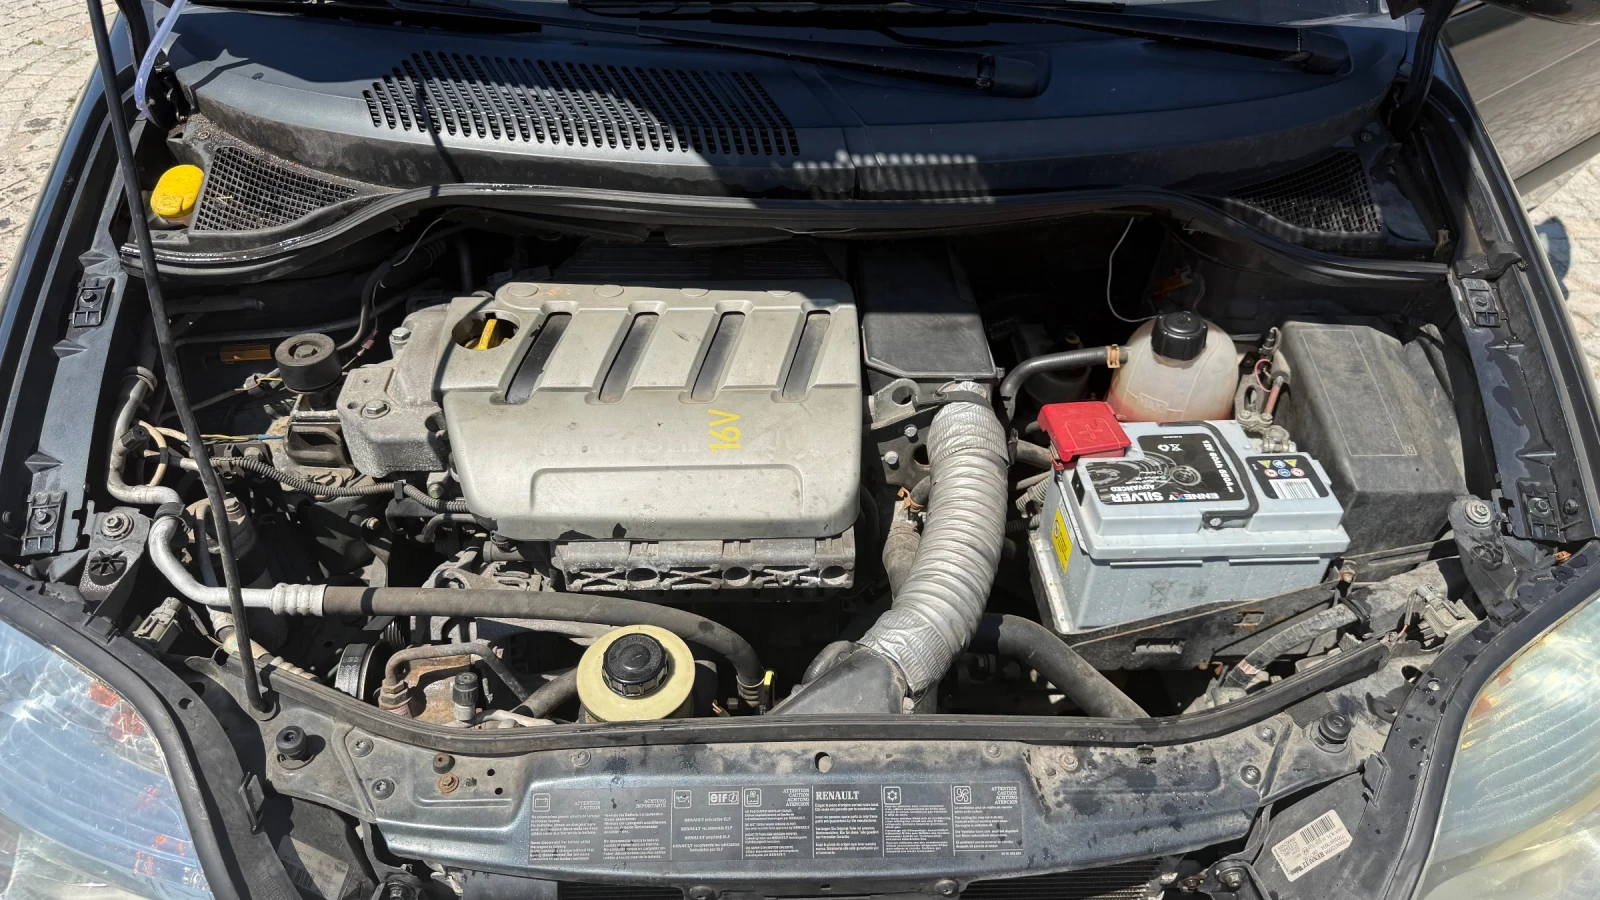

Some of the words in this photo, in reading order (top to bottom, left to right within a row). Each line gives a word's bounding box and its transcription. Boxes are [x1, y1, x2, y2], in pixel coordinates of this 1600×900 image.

[708, 409, 732, 443] 16V
[1202, 440, 1215, 450] 12V
[1208, 452, 1224, 468] 60Ah
[1110, 492, 1164, 502] SILVER
[1168, 492, 1220, 502] ENNEXY
[816, 791, 860, 800] RENAULT
